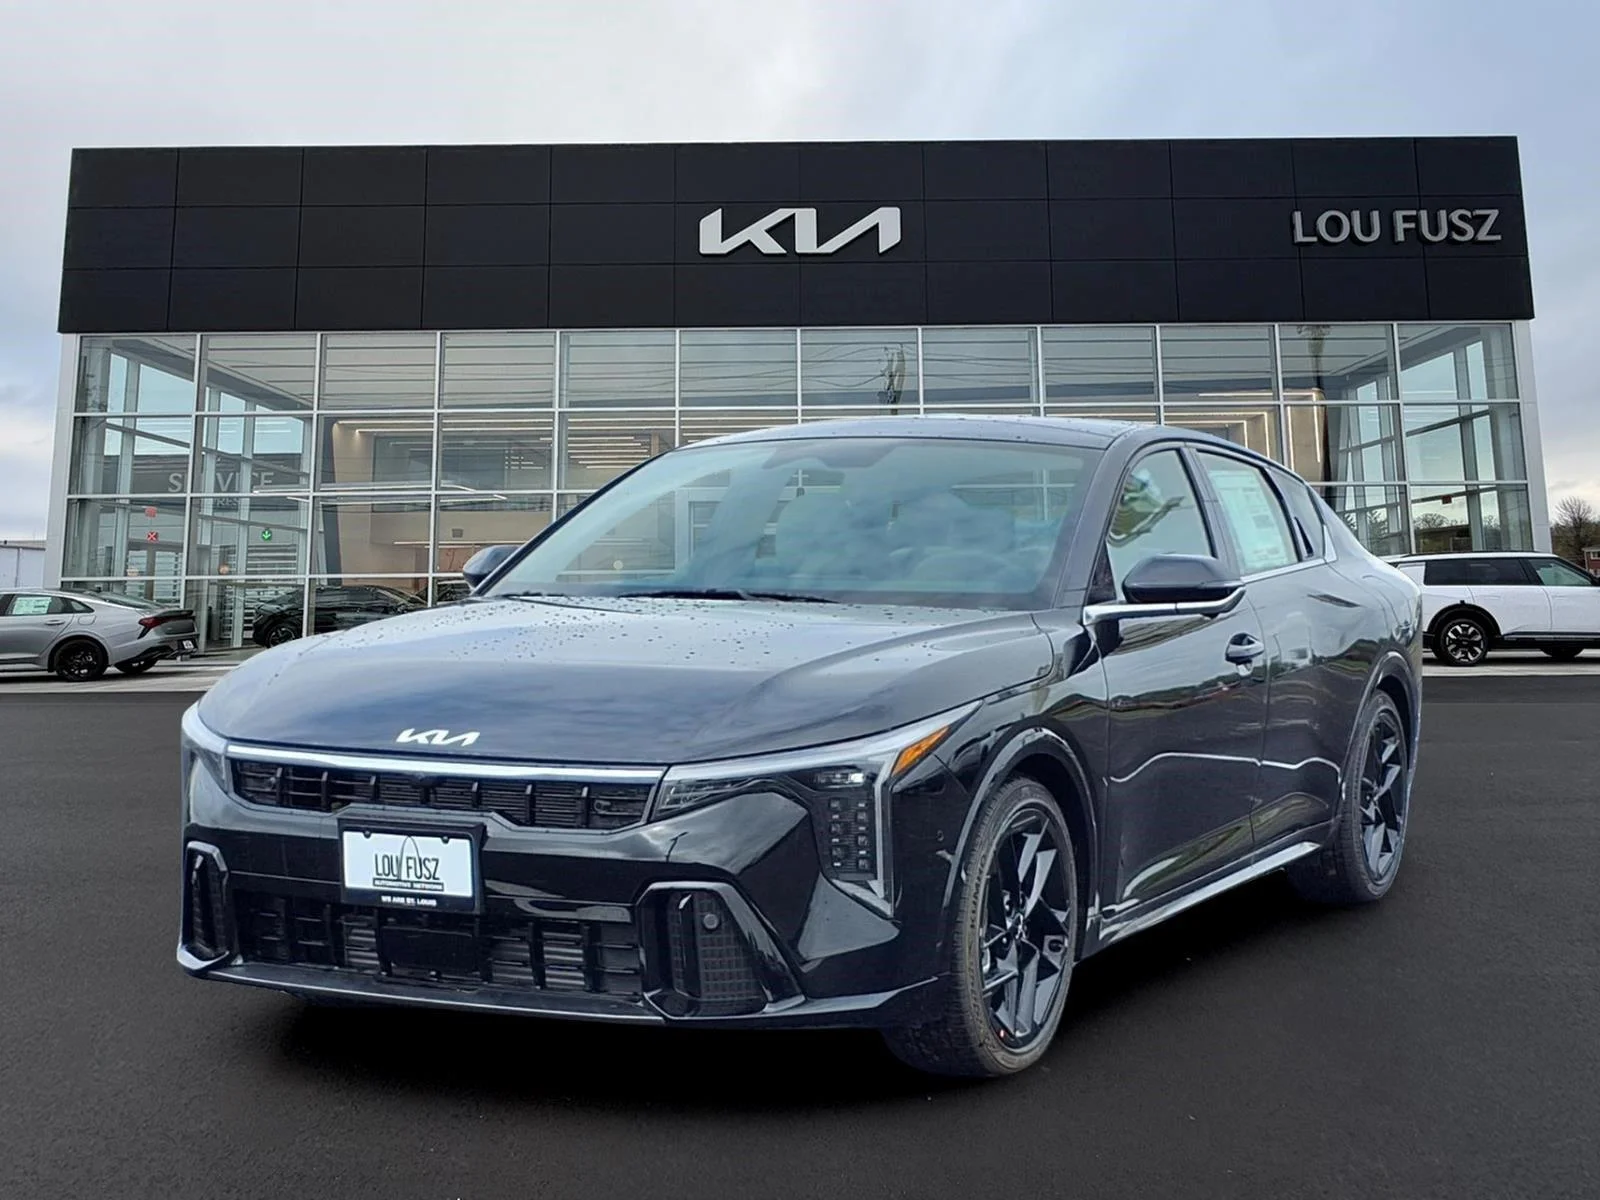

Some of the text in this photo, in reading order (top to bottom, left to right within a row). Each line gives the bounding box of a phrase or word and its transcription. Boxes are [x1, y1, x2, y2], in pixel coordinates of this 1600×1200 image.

[699, 207, 901, 254] KIA
[1292, 208, 1502, 244] LOU FUSZ
[396, 727, 481, 747] KIA
[375, 854, 440, 880] LOU FUSZ
